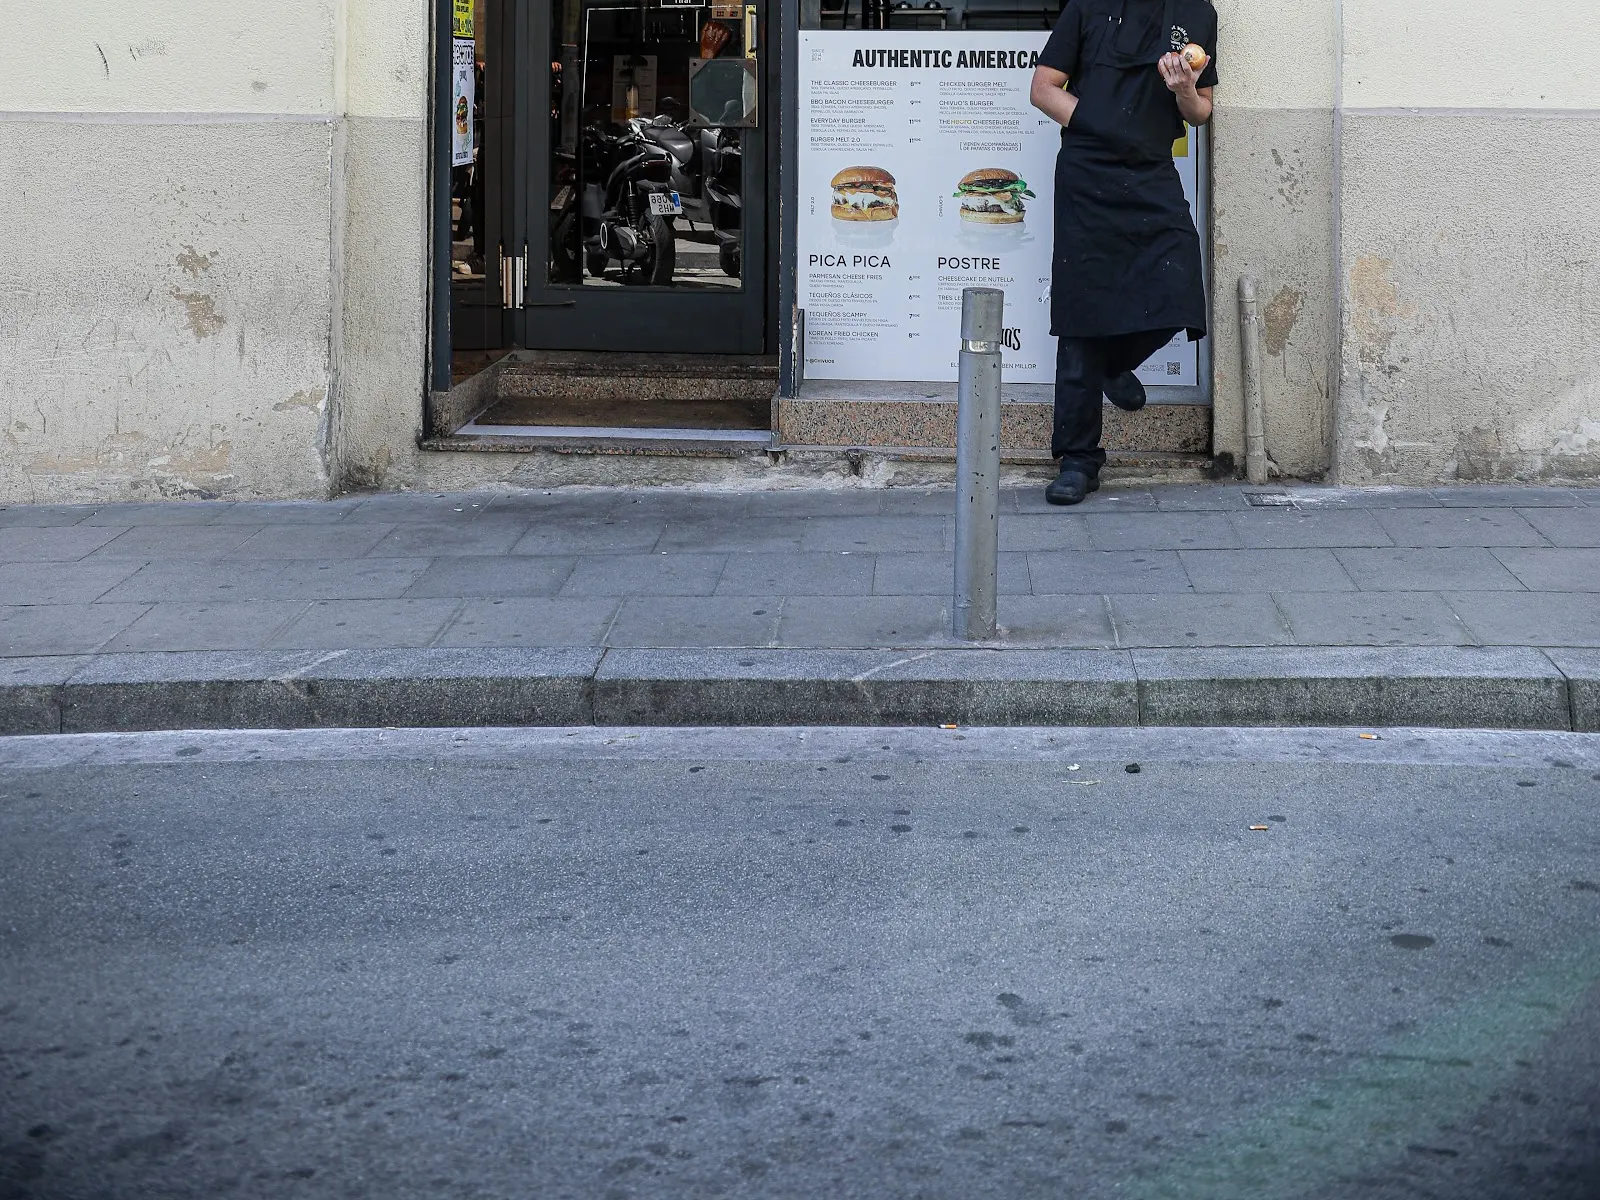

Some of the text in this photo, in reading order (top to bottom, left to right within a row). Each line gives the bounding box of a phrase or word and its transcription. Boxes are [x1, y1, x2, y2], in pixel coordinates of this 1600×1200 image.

[852, 49, 1040, 68] AUTHENTIC AMERICA
[809, 255, 891, 267] PICA PICA
[938, 257, 1000, 270] POSTRE
